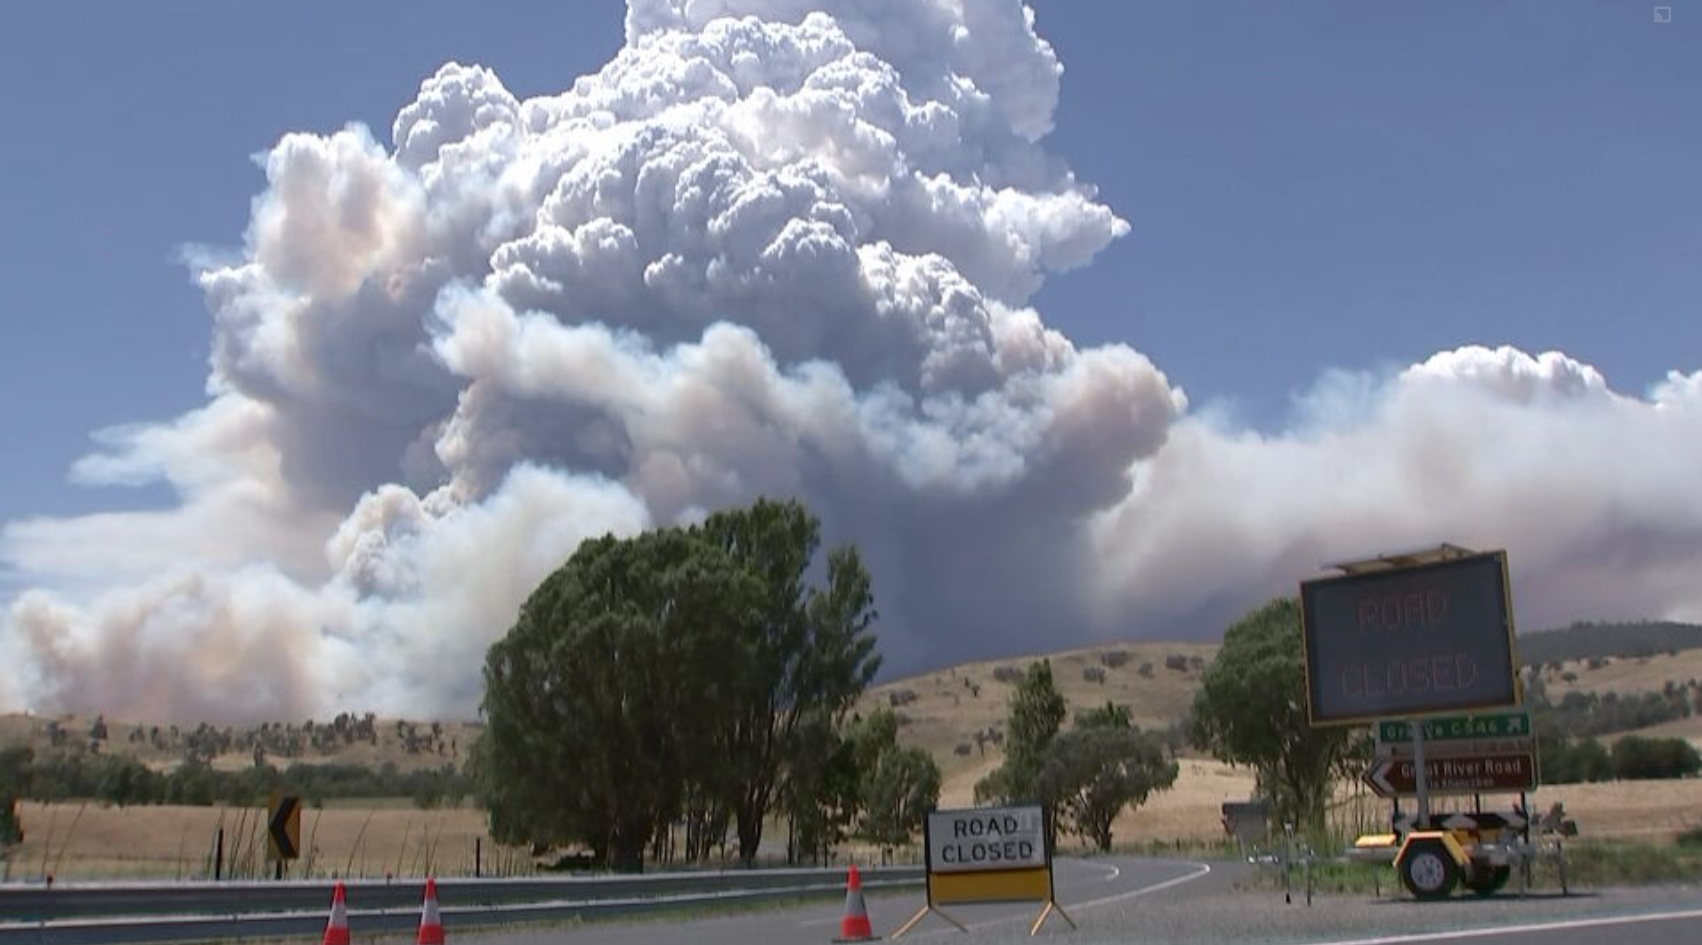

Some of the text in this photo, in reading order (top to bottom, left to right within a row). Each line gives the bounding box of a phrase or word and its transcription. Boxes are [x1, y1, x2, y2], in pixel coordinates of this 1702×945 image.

[1357, 590, 1449, 631] ROAD
[1338, 651, 1479, 694] CLOSED
[1401, 758, 1521, 777] Grat River Road
[954, 816, 1018, 838] ROAD
[942, 841, 1033, 863] CLOSED
